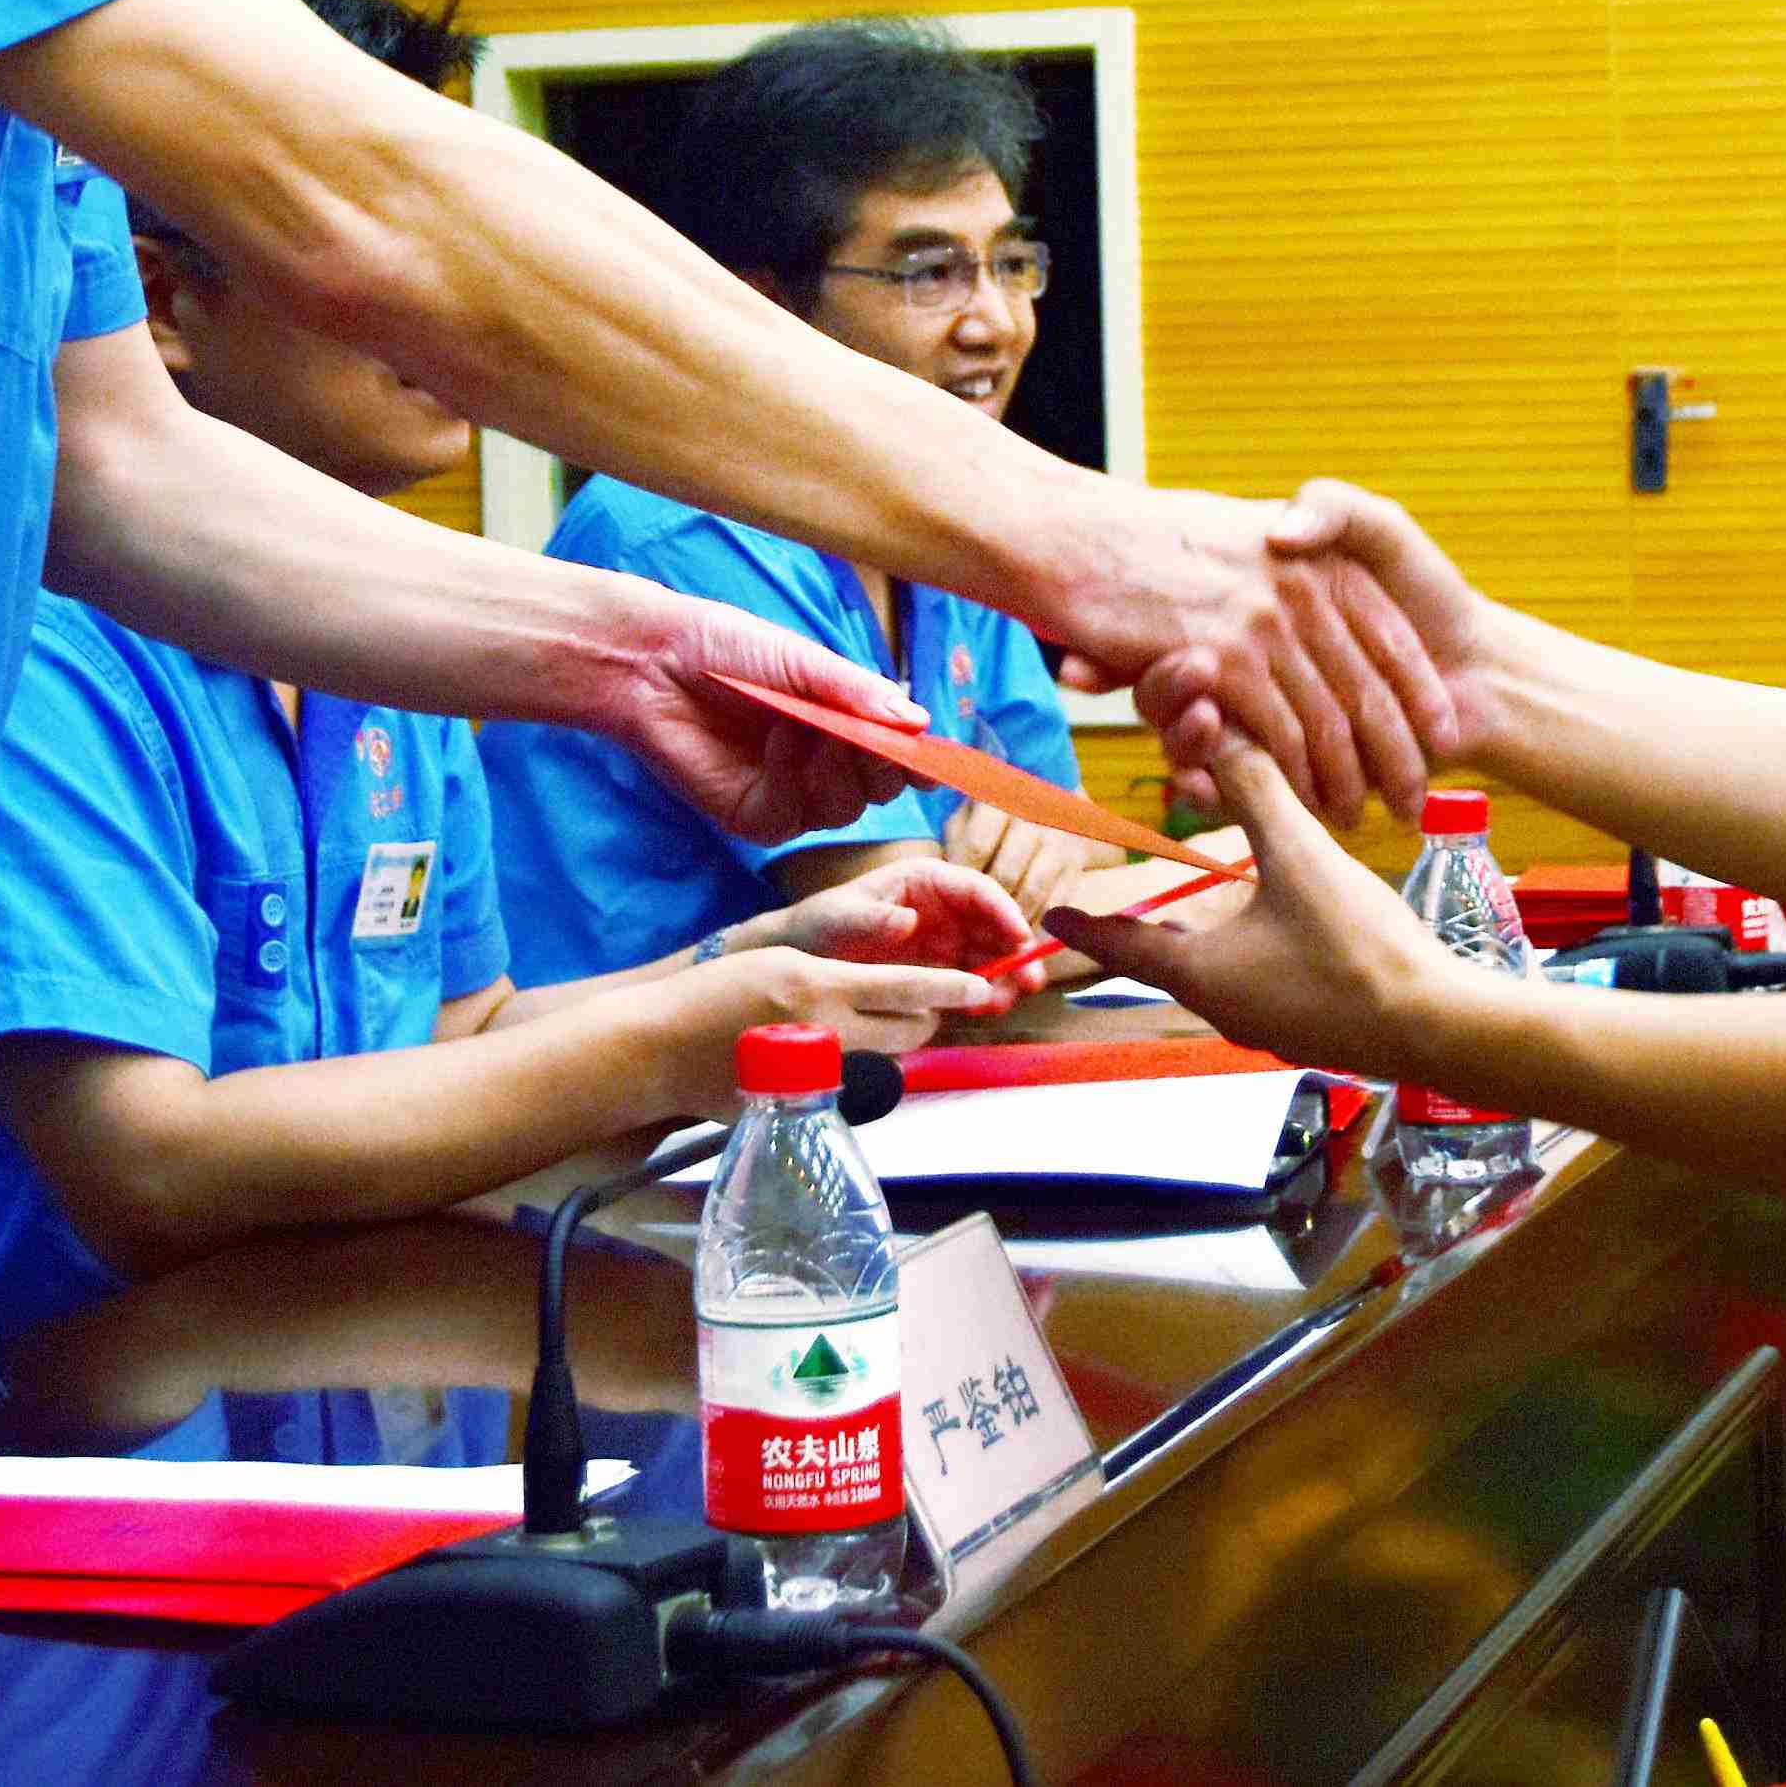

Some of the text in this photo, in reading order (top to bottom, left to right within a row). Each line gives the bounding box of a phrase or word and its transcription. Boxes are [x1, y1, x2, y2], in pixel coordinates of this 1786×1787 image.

[761, 1427, 879, 1469] 农夫山泉
[762, 1462, 880, 1490] NONGFU SPRING
